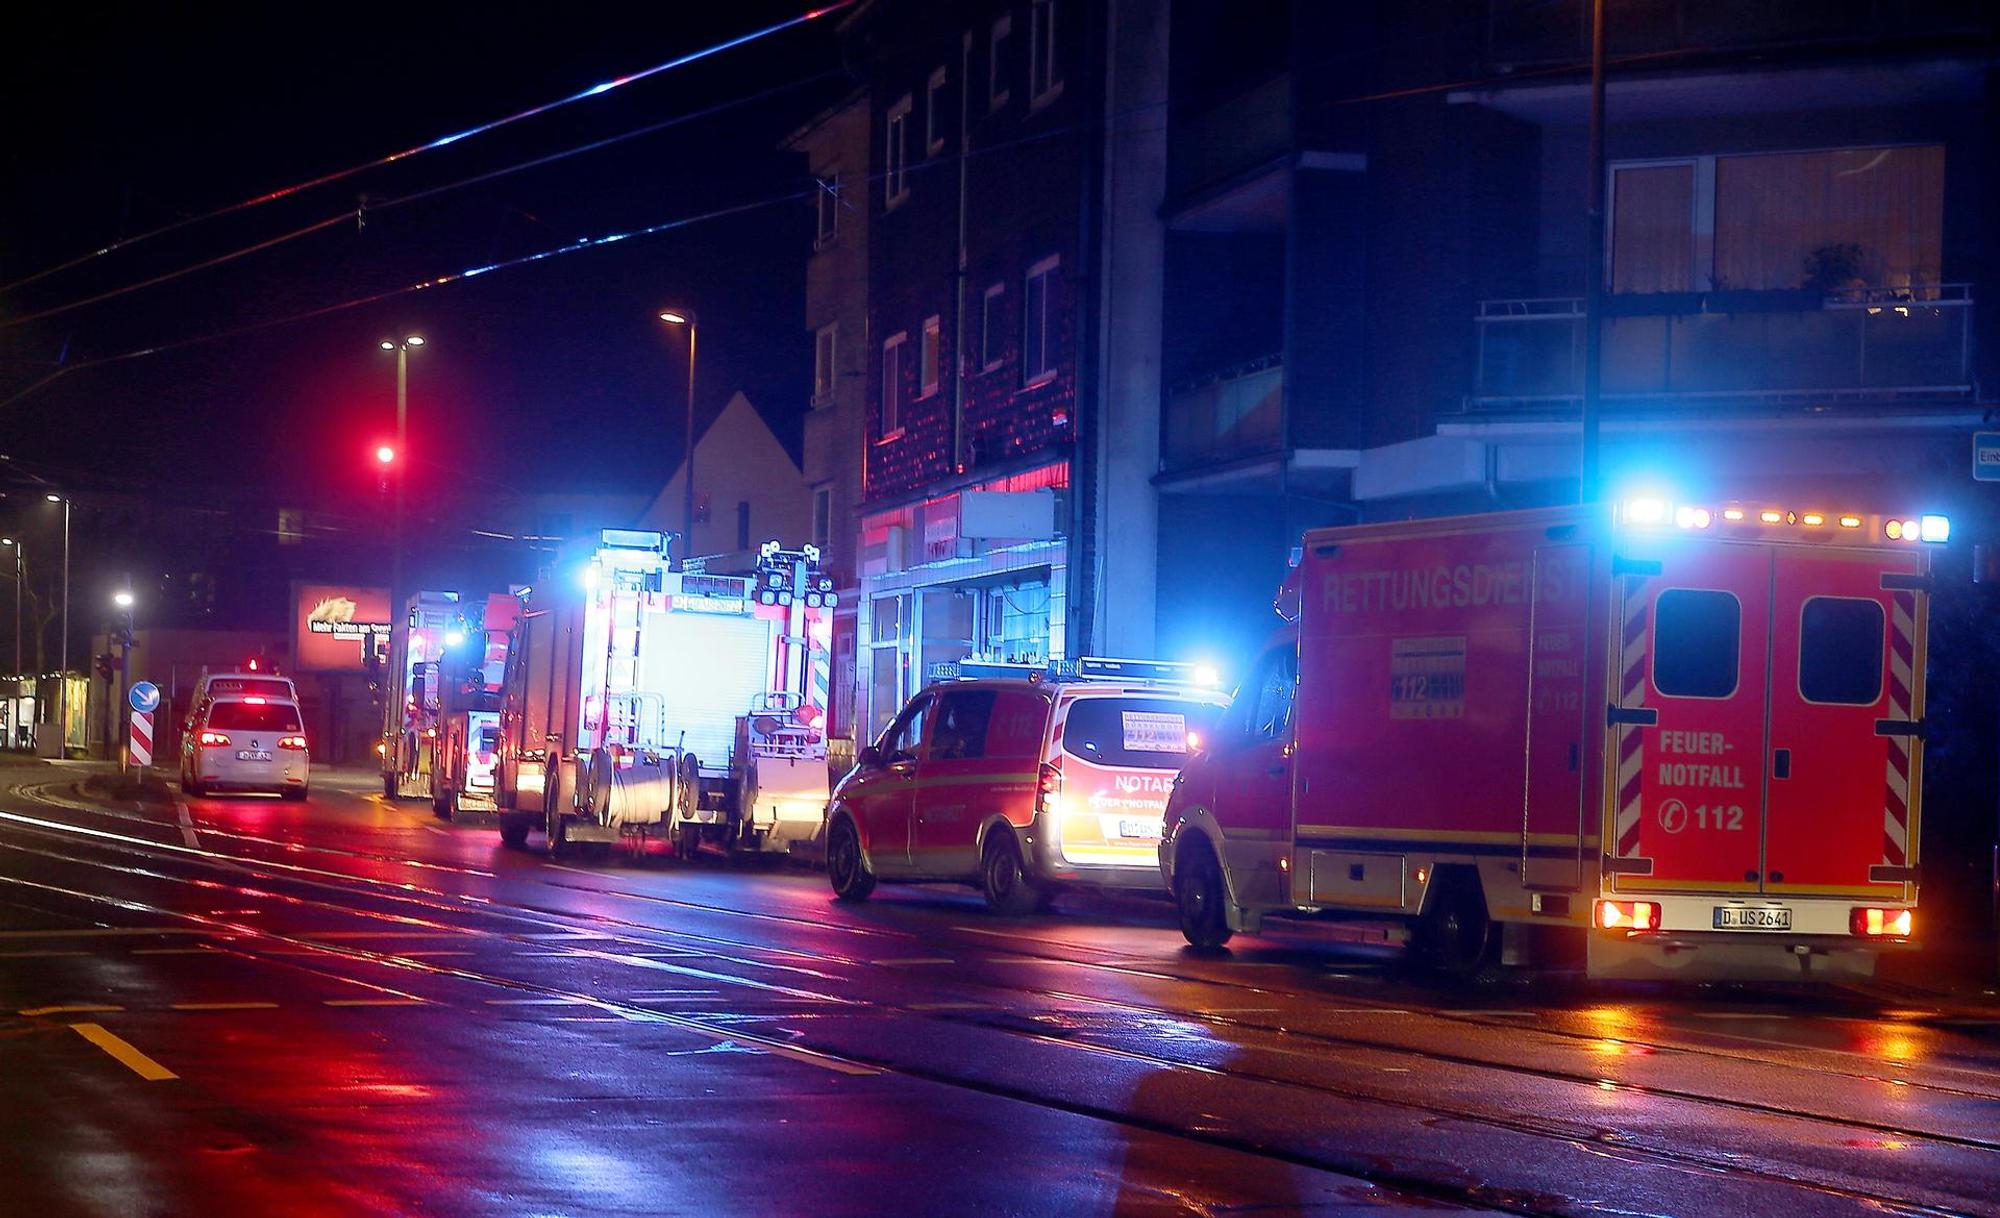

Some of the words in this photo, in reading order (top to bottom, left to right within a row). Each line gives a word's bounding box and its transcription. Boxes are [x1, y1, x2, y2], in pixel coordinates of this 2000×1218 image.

[1323, 560, 1578, 613] RETTUNGSDIENST
[1401, 676, 1427, 699] 112
[1661, 730, 1734, 755] FEUER-
[1660, 763, 1745, 788] NOTFALL
[1695, 804, 1744, 830] 112
